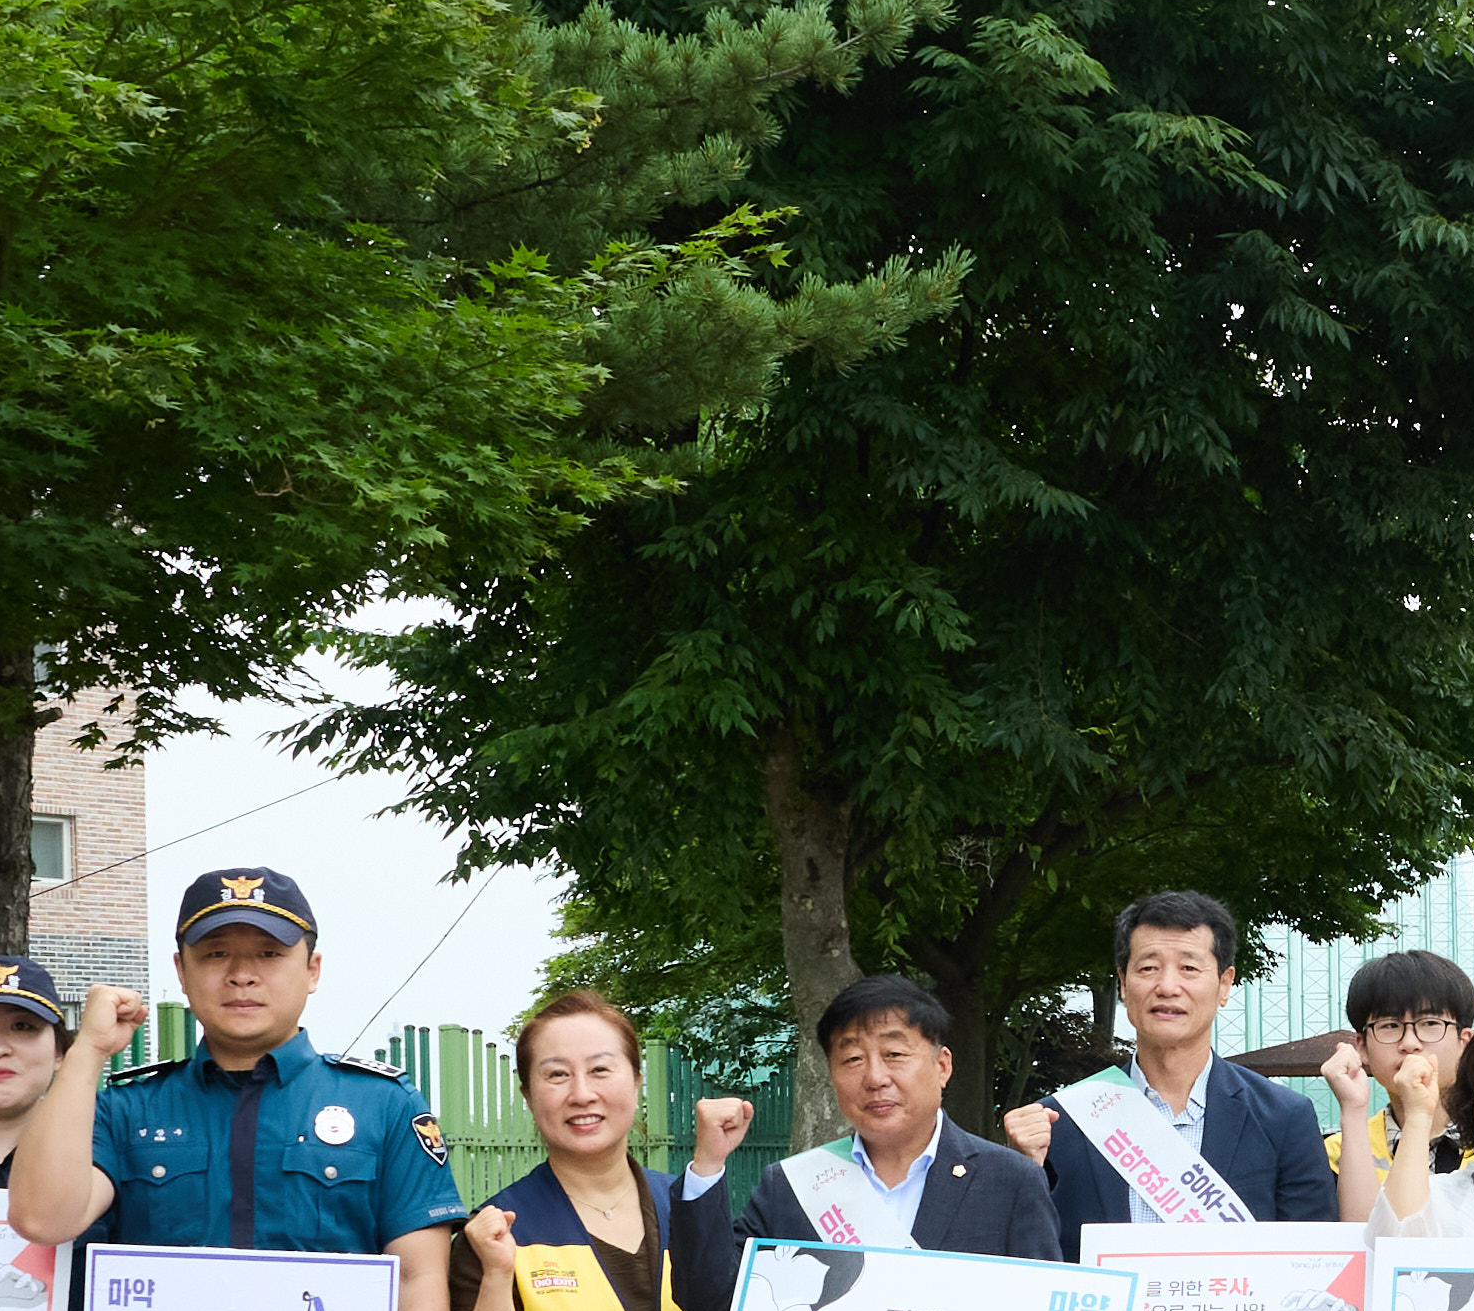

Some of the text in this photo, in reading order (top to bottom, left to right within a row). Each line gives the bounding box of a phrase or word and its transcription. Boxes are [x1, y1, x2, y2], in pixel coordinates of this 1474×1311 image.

[1103, 1128, 1187, 1215] 마약없는
[1180, 1163, 1246, 1223] 양주시
[108, 1278, 155, 1309] 마약
[1168, 1278, 1254, 1298] 위한 주사,
